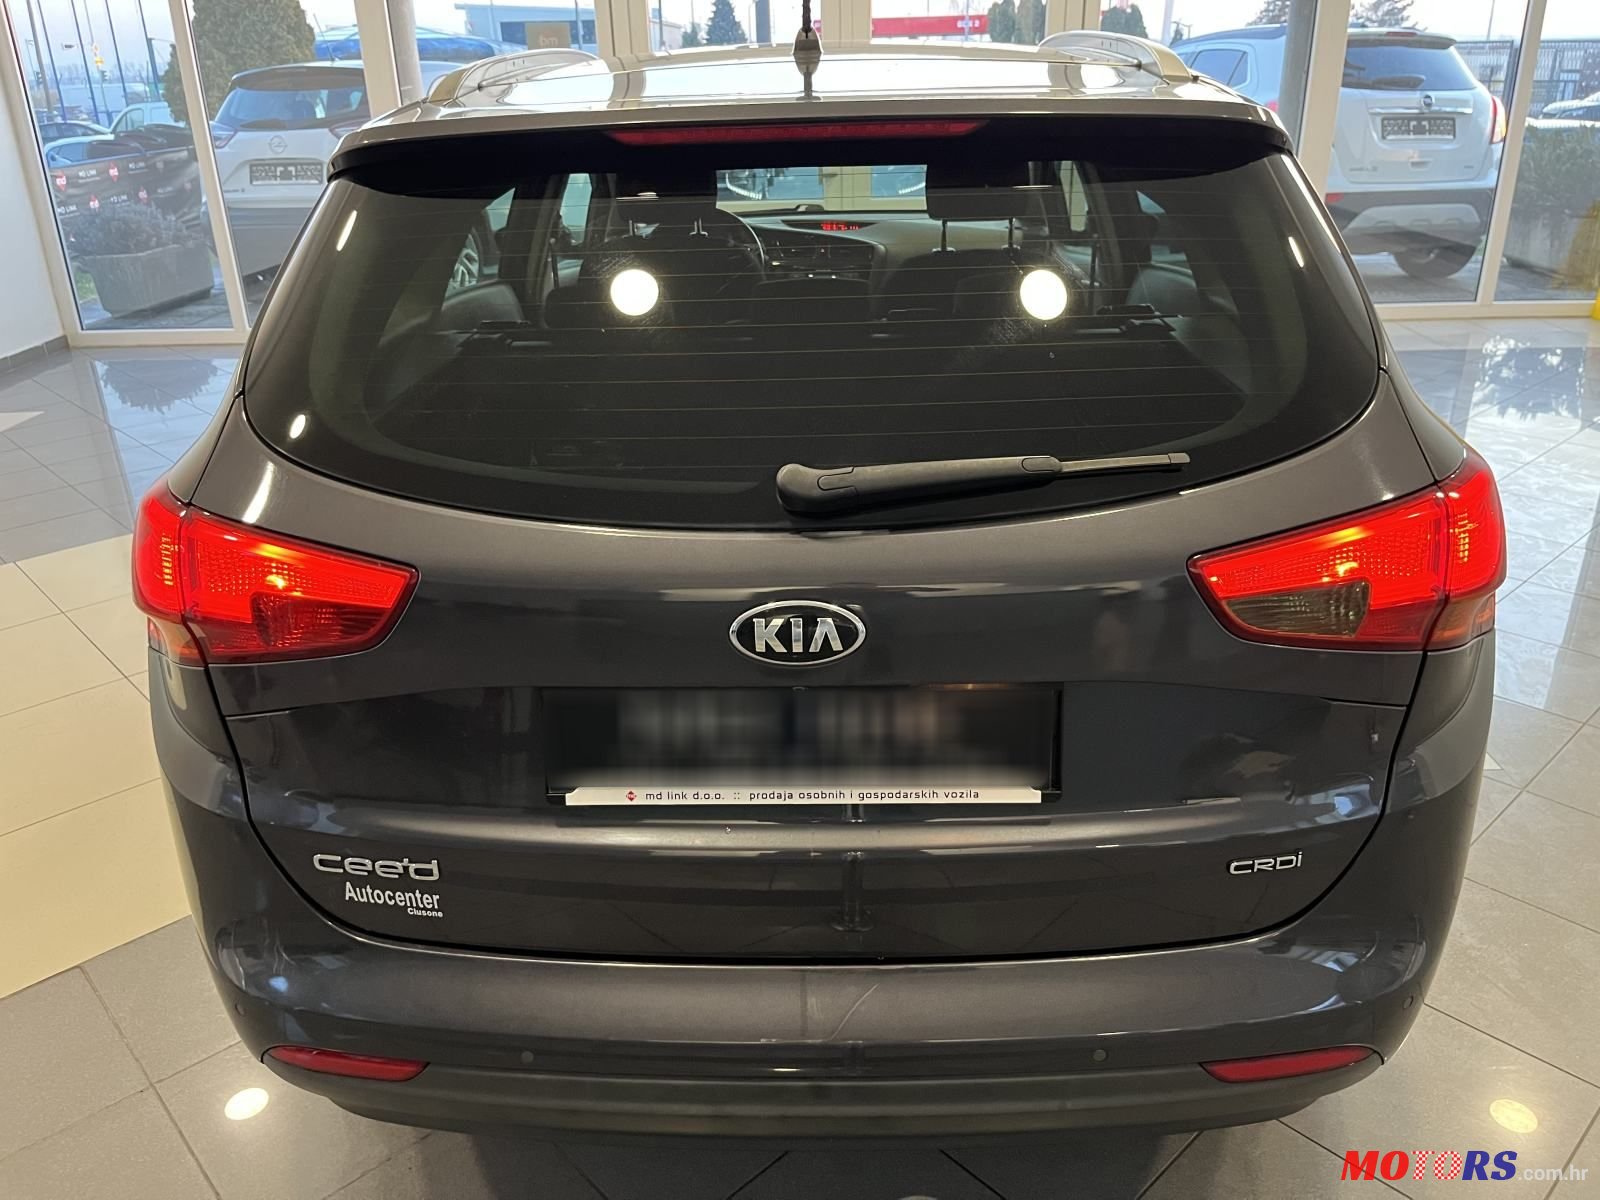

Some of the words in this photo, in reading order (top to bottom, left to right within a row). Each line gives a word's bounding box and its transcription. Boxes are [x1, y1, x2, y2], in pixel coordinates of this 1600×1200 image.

[752, 617, 844, 653] KIA
[645, 791, 662, 800] md
[667, 791, 687, 800] link
[692, 791, 725, 800] d.o.o.
[750, 791, 794, 802] prodaja
[799, 790, 846, 800] osobnih
[858, 790, 939, 802] gospodarskih
[944, 790, 980, 799] vozila
[1229, 851, 1303, 875] CRDi
[344, 881, 440, 909] Autocenter
[407, 907, 443, 918] Clusone
